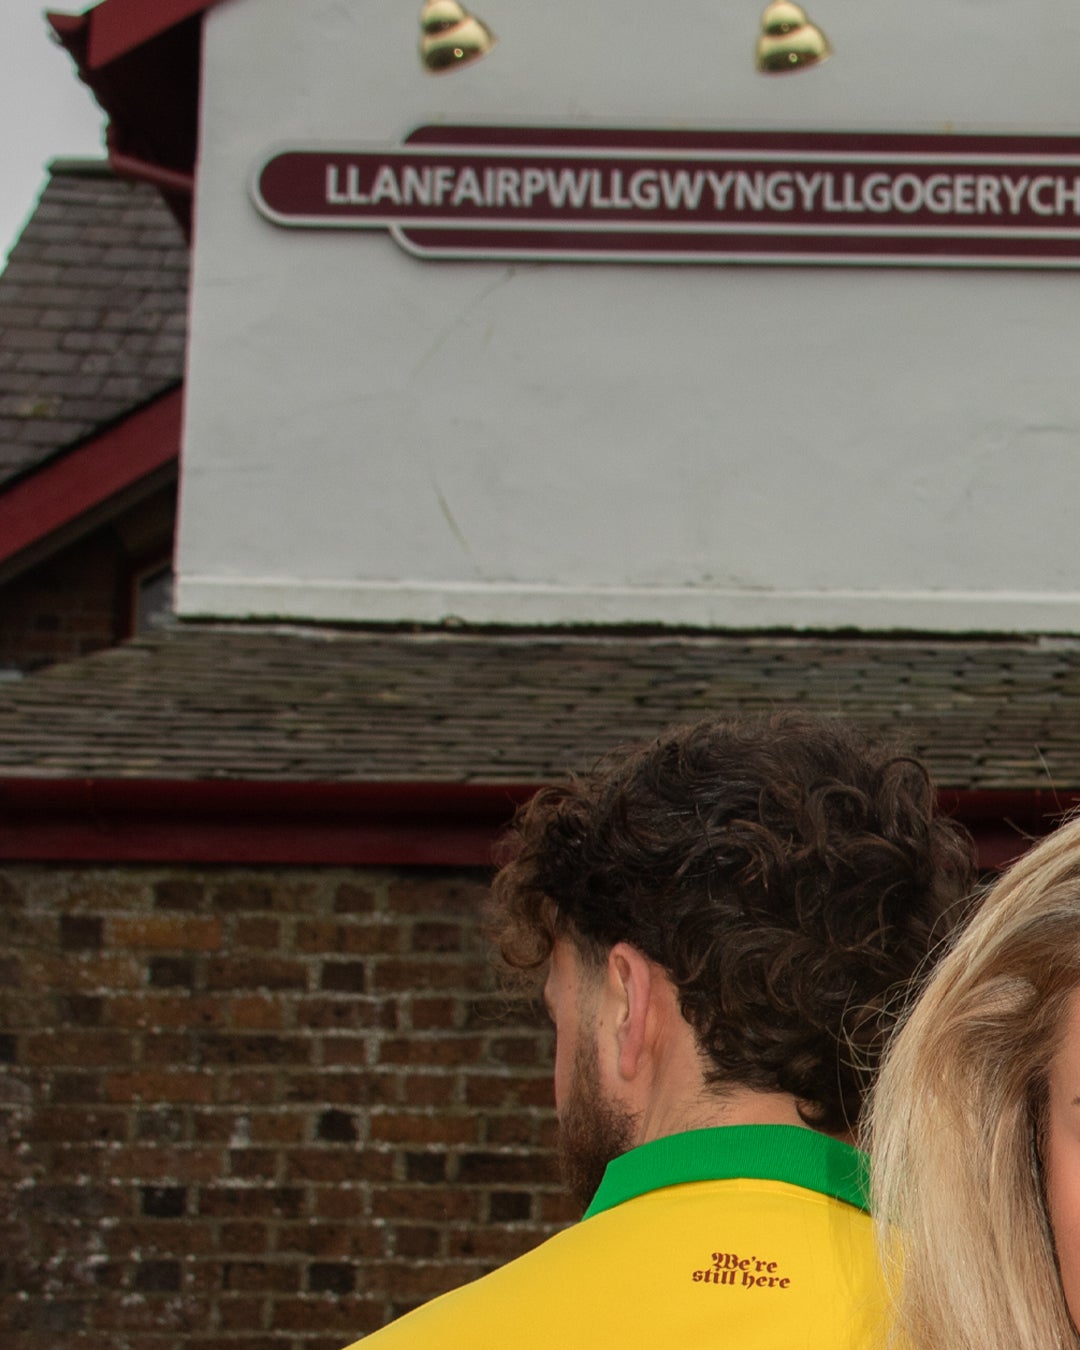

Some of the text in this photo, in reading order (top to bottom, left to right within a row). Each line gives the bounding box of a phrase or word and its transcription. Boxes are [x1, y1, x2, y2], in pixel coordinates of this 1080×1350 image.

[711, 1252, 779, 1274] We're
[692, 1268, 791, 1289] still here
